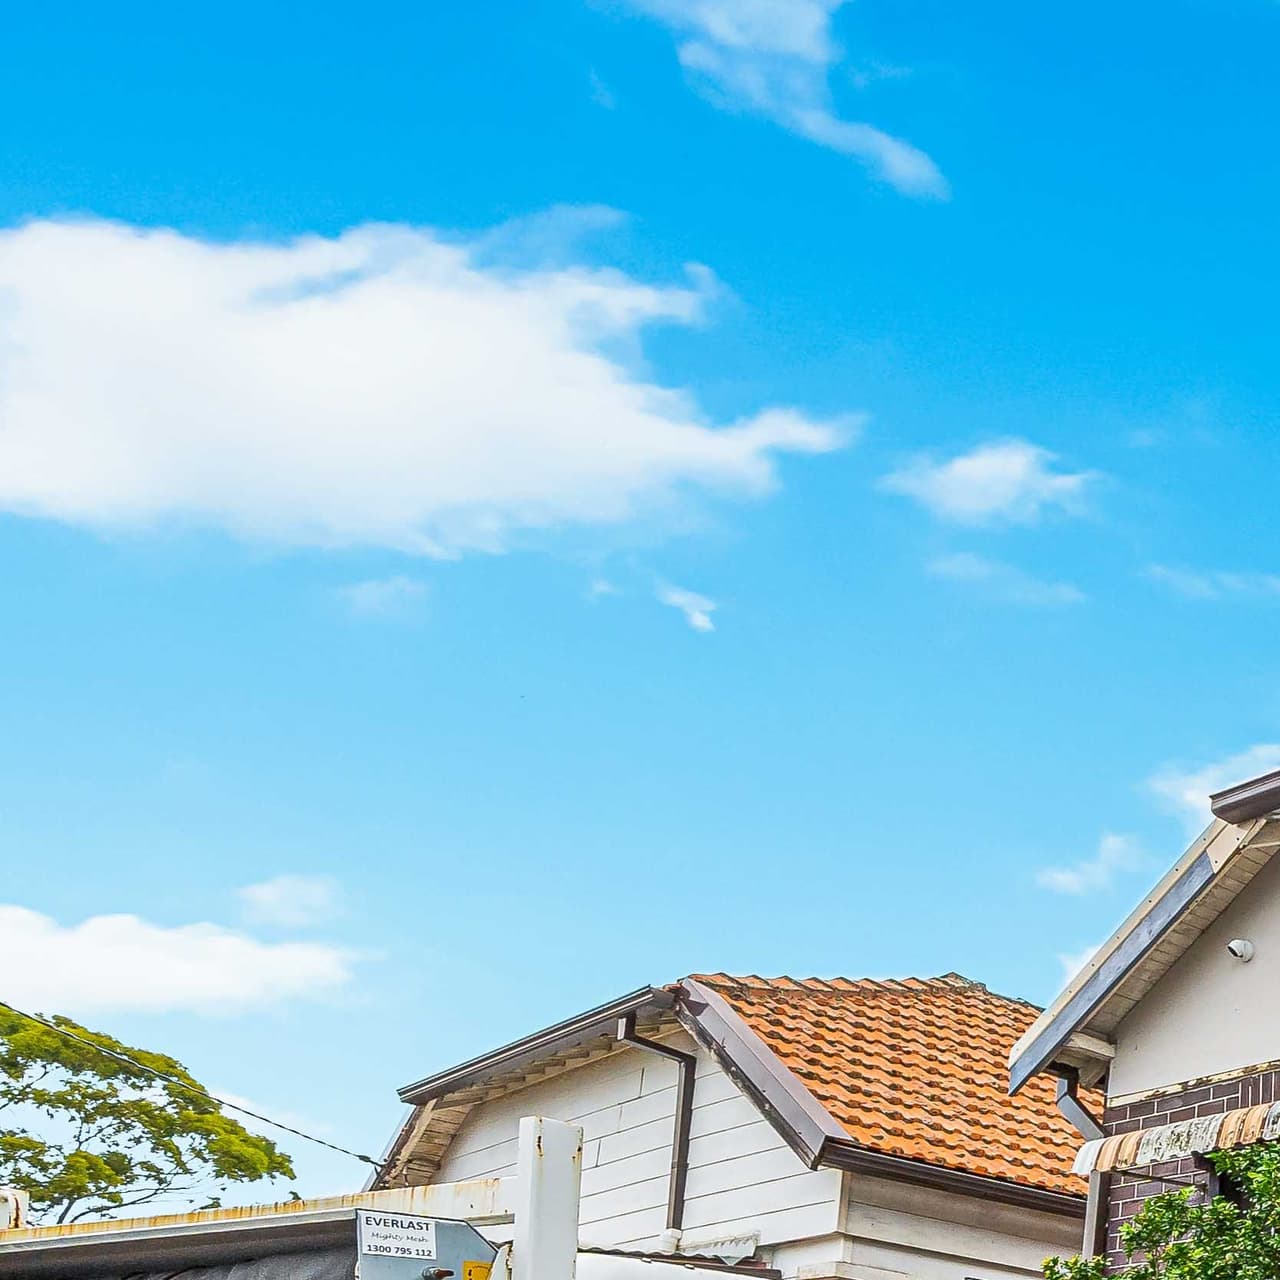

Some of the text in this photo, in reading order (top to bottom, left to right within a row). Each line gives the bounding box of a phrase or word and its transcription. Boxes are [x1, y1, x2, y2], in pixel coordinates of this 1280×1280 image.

[365, 1216, 431, 1231] EVERLAST
[367, 1244, 432, 1257] 1300 795 112
